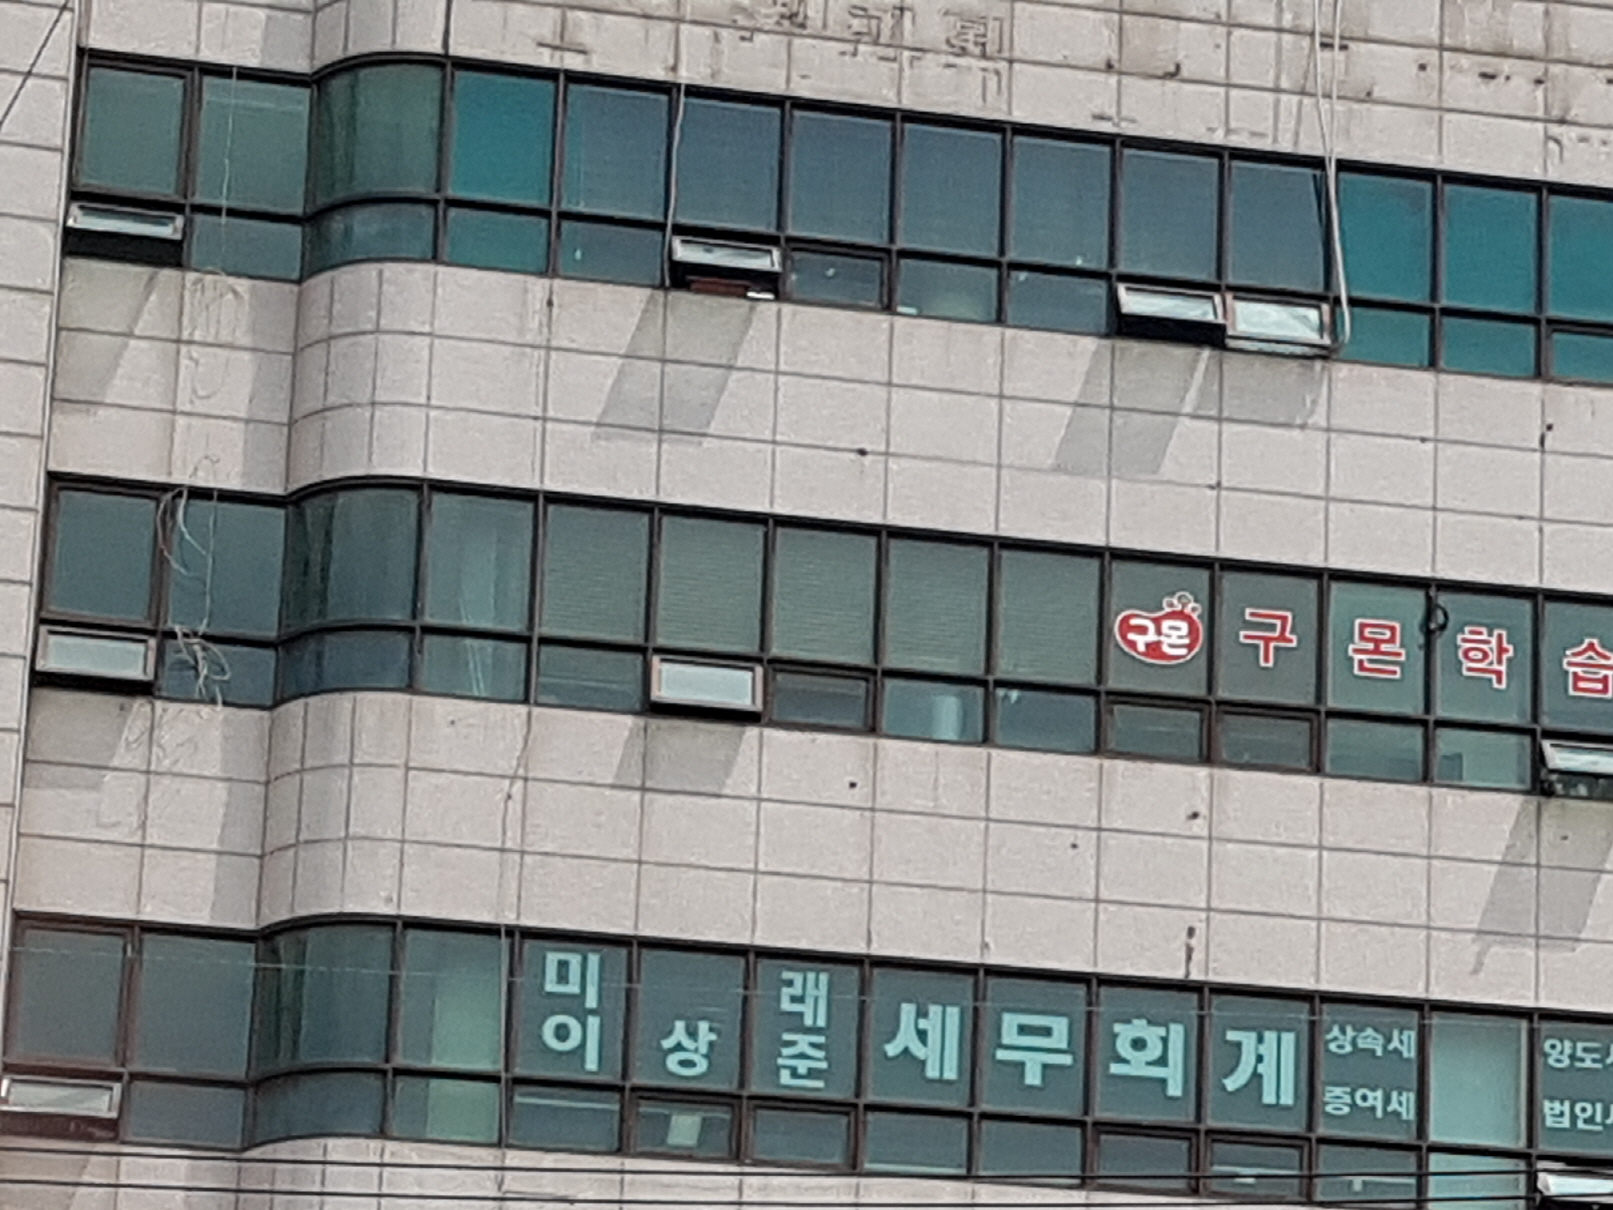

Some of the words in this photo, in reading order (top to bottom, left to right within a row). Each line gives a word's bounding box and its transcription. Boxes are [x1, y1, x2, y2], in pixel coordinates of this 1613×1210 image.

[1127, 617, 1190, 656] 구몬
[1324, 1023, 1416, 1060] 상속세
[1322, 1085, 1416, 1121] 증여세
